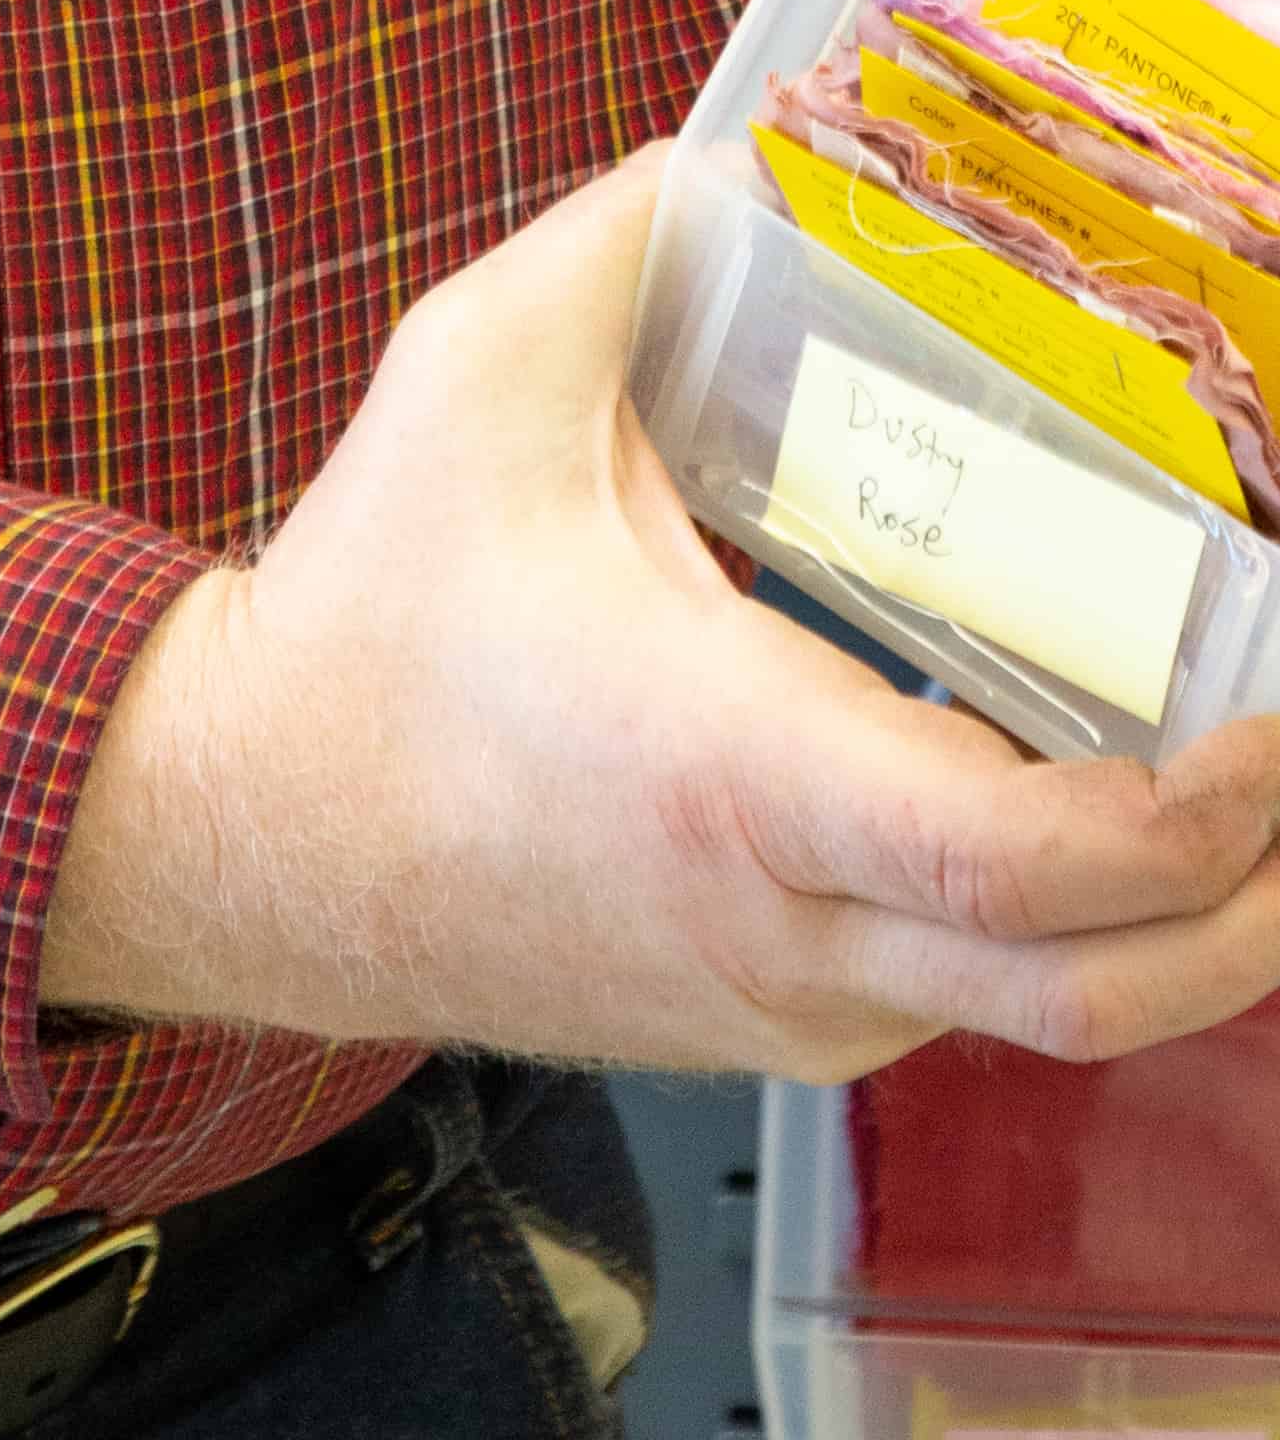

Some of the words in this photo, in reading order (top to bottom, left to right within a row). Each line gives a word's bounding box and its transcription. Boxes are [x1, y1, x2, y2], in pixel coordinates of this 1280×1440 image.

[1055, 4, 1101, 44] 2017
[1104, 35, 1216, 118] PANTONE®
[909, 95, 956, 130] Color
[960, 156, 1075, 234] PANTONE®
[847, 377, 965, 518] Dusty
[857, 475, 954, 558] Rose
